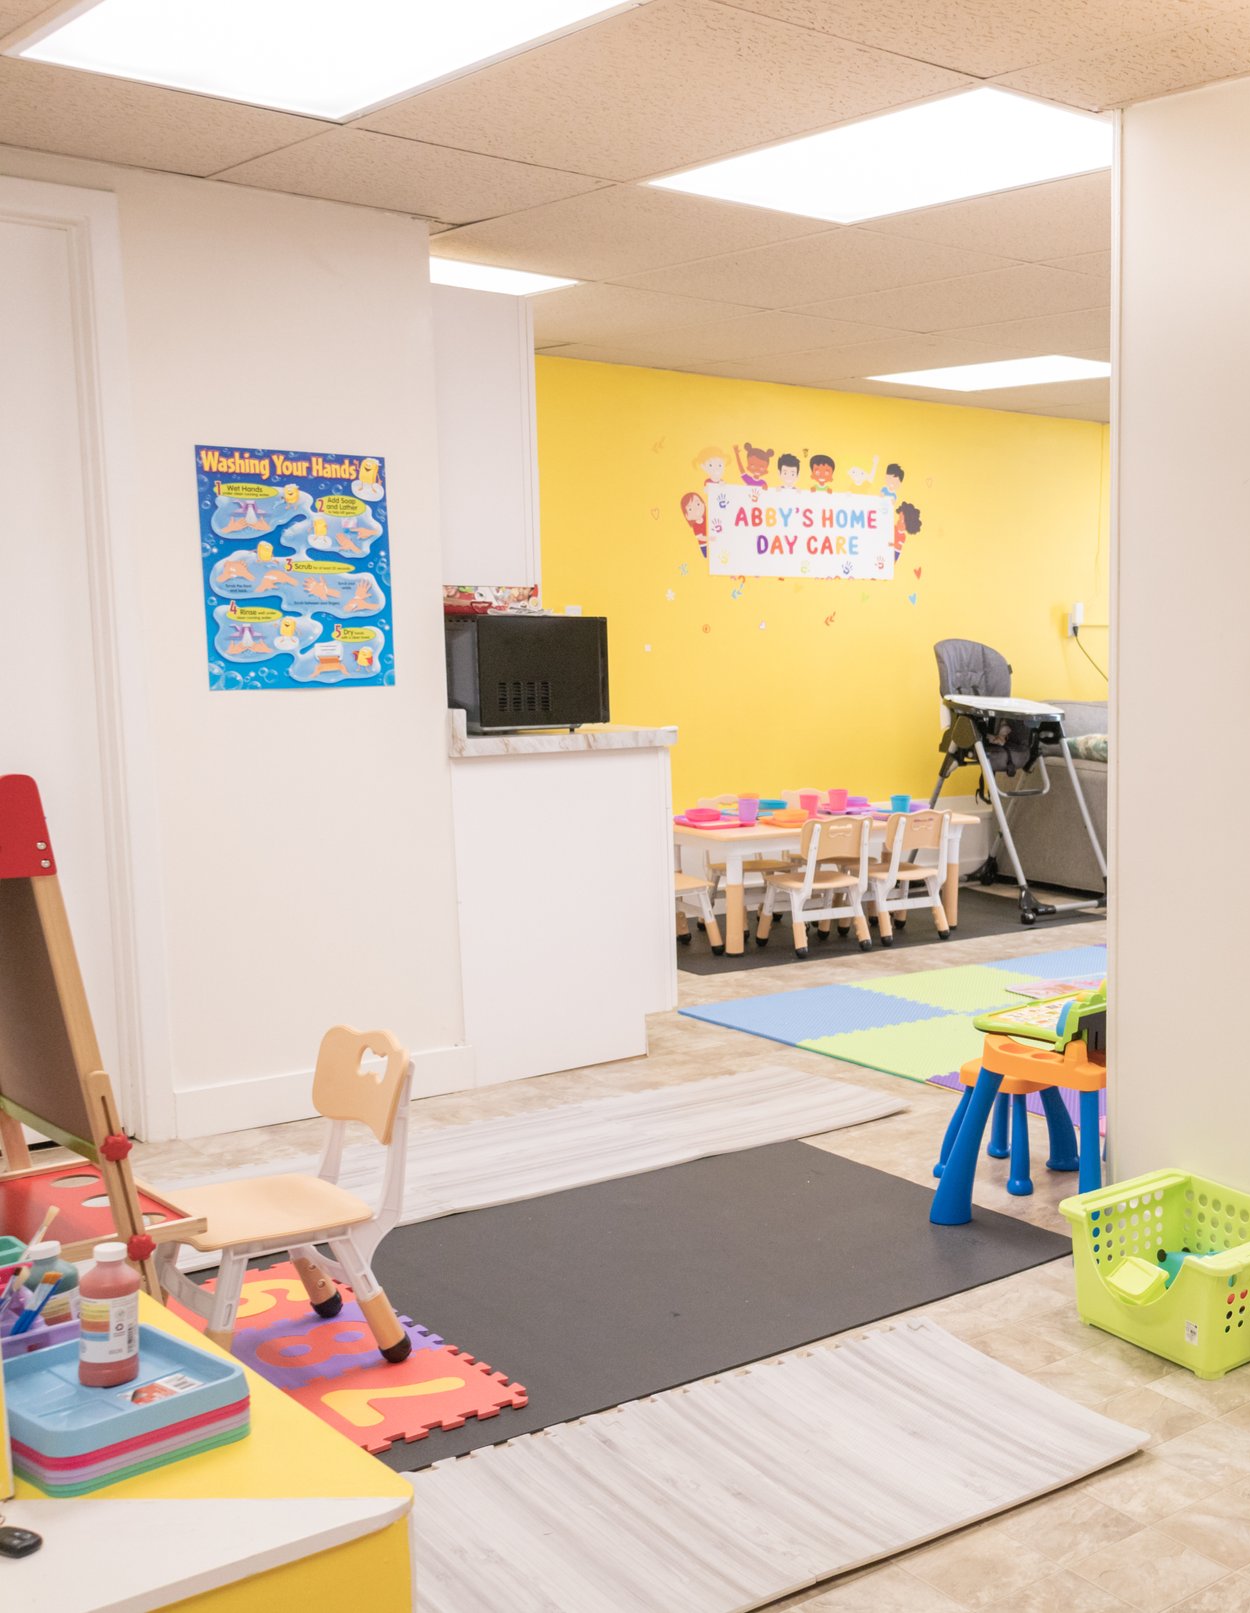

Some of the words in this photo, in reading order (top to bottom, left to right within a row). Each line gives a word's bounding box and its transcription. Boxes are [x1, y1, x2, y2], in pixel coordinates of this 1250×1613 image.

[200, 450, 270, 480] Washing
[272, 454, 309, 477] Your
[311, 456, 357, 480] Hands
[215, 481, 221, 495] 1
[241, 485, 263, 493] Hands
[318, 499, 324, 512] 2
[734, 507, 814, 528] ABBY'S
[822, 509, 877, 529] HOME
[756, 535, 798, 555] DAY
[806, 536, 859, 555] CARE
[286, 559, 292, 572] 3
[230, 600, 237, 615] 4
[335, 625, 341, 638] 5
[255, 1321, 383, 1367] 8
